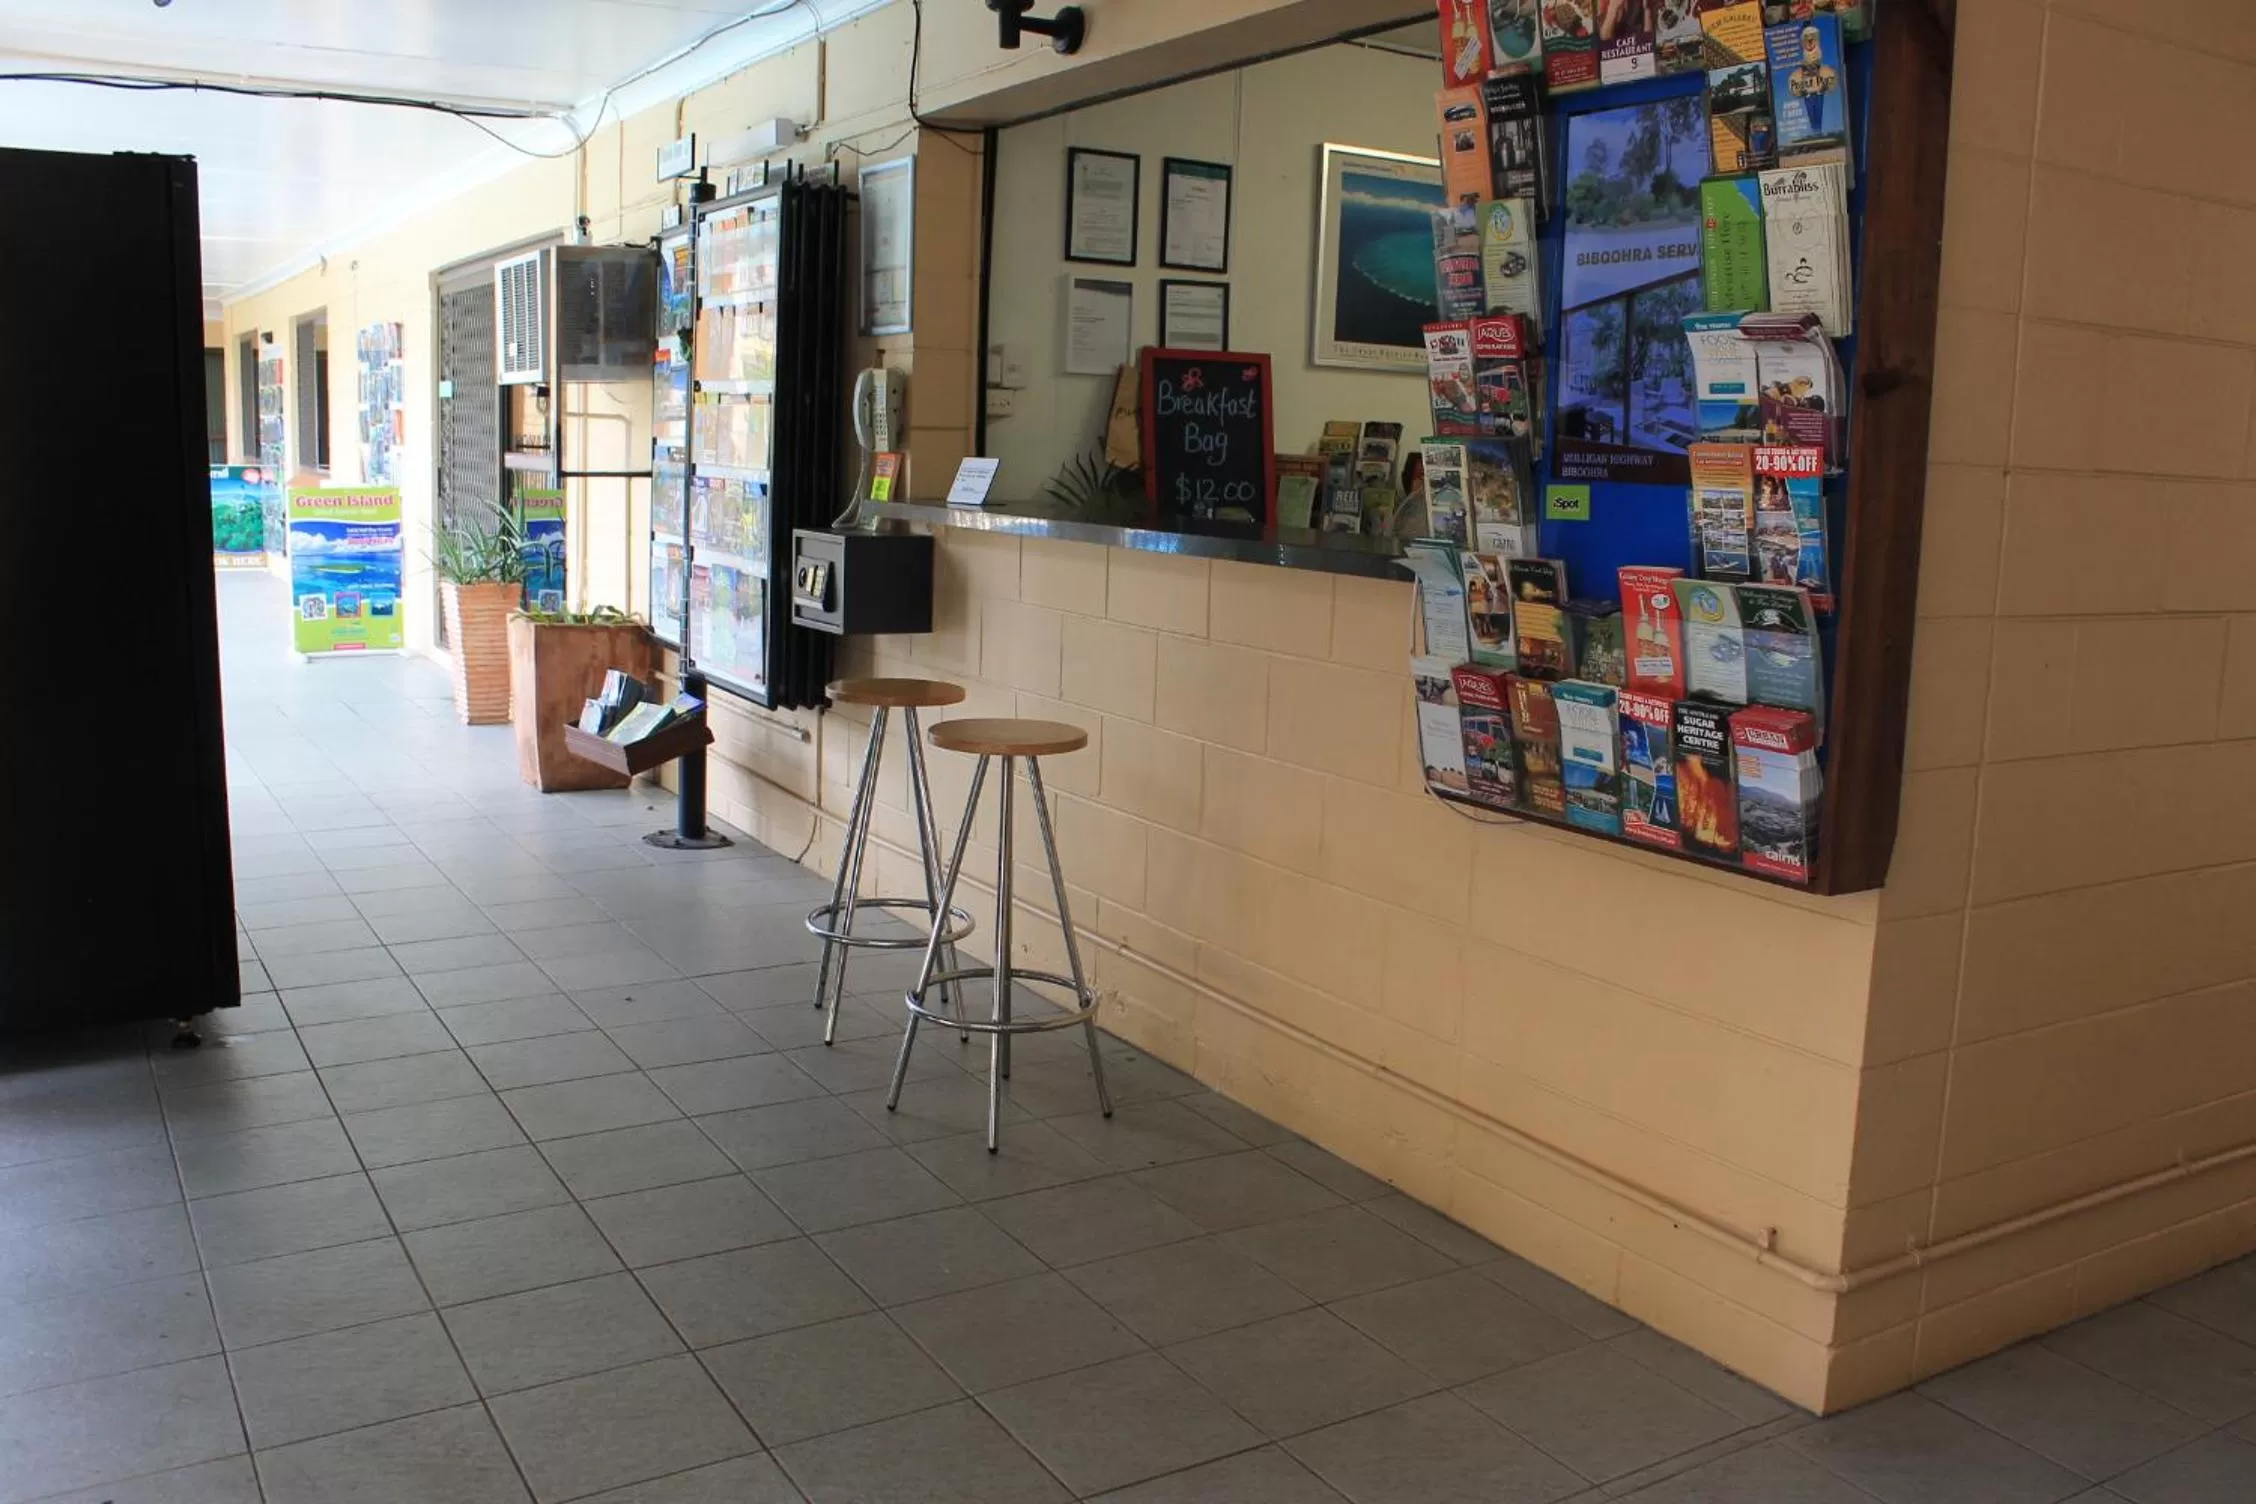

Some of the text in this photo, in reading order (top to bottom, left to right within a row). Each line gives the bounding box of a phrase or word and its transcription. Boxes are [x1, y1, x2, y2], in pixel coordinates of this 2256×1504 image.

[1601, 42, 1652, 60] RESTAURANT
[1577, 248, 1652, 266] BIBOOHRA
[1157, 379, 1257, 427] Breakfast
[1184, 421, 1228, 466] Bag
[295, 495, 394, 508] Green Island
[1683, 715, 1716, 730] SUGAR
[1676, 724, 1725, 742] HERITAGE
[1682, 735, 1720, 751] CENTRE
[1764, 849, 1801, 867] cairns
